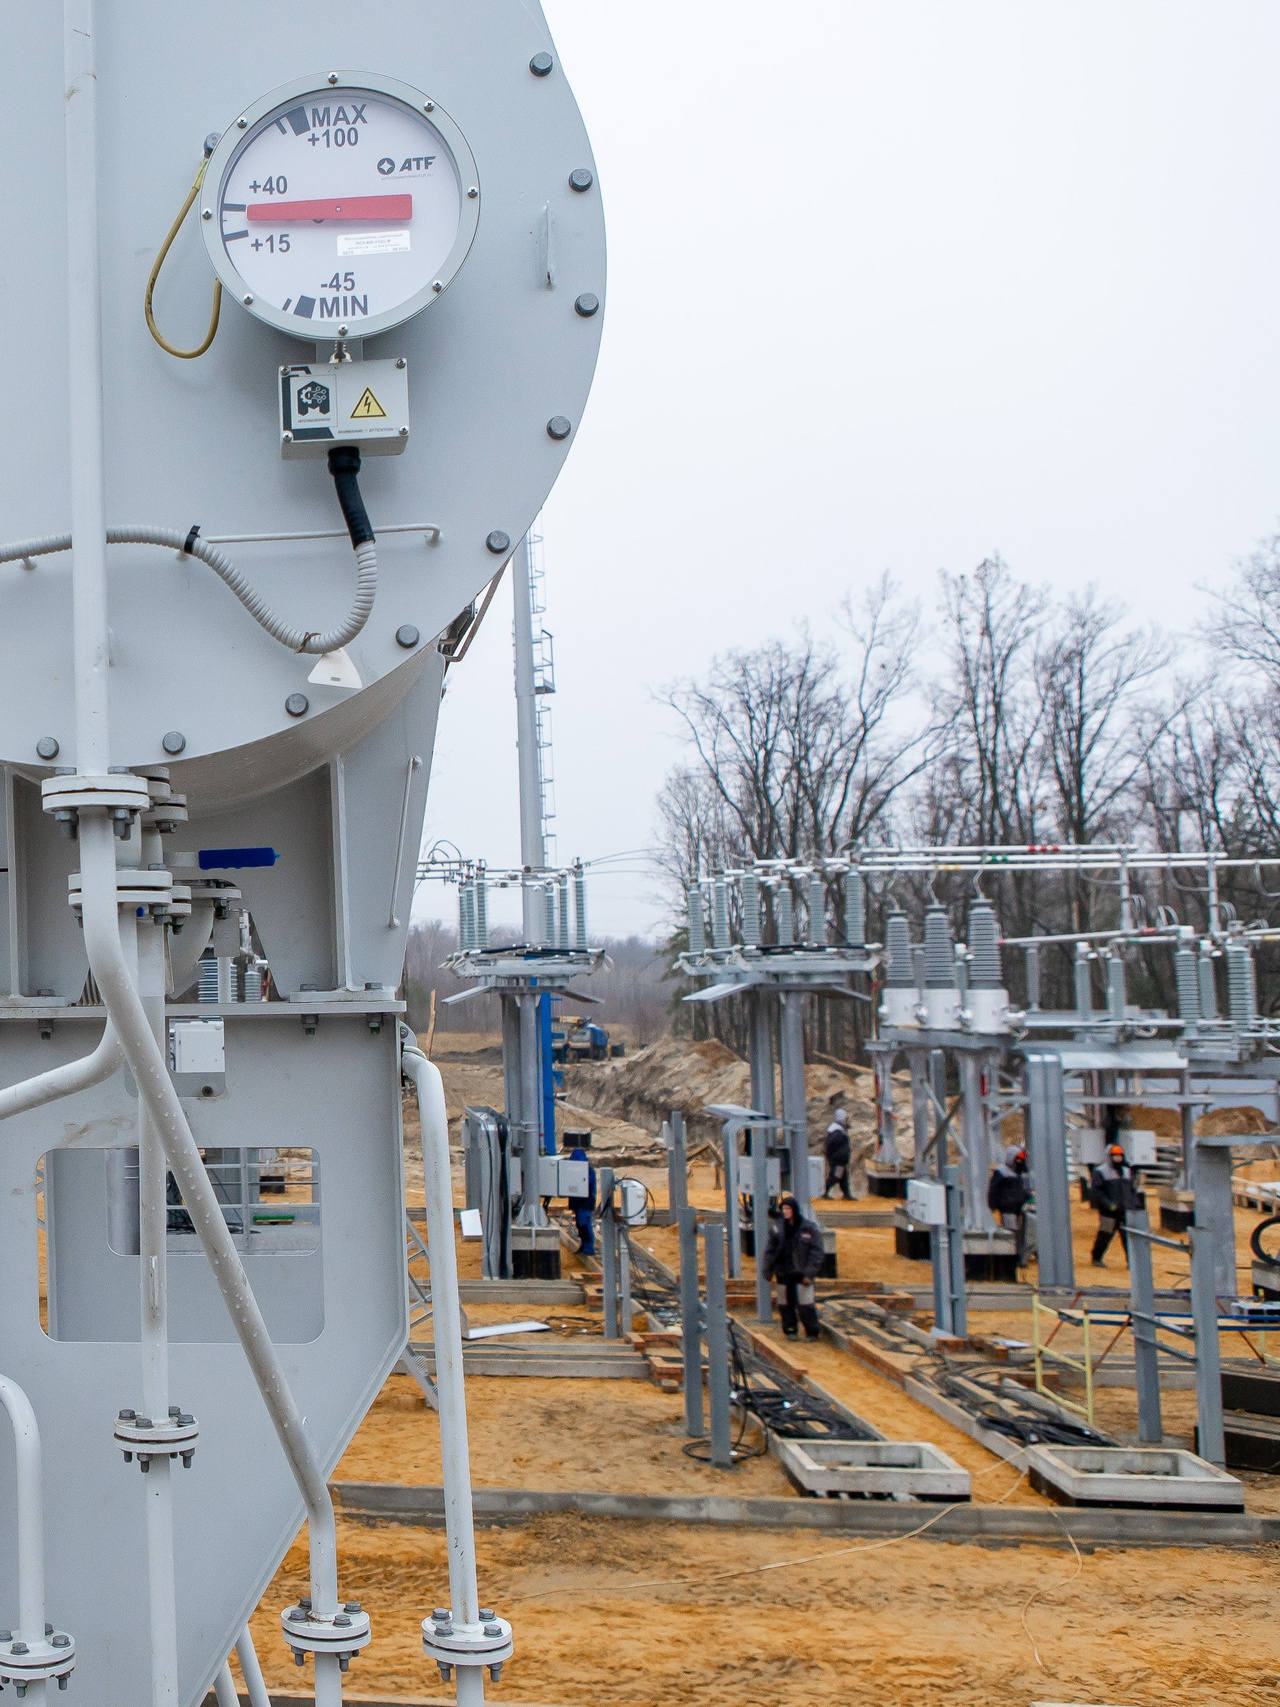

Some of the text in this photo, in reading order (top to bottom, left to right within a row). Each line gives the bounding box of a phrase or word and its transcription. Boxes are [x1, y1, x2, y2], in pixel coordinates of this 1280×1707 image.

[311, 104, 368, 128] MAX
[307, 127, 359, 148] +100
[399, 156, 436, 172] ATF
[249, 175, 288, 195] +40
[251, 234, 291, 254] +15
[321, 272, 356, 292] -45
[320, 295, 368, 318] MIN
